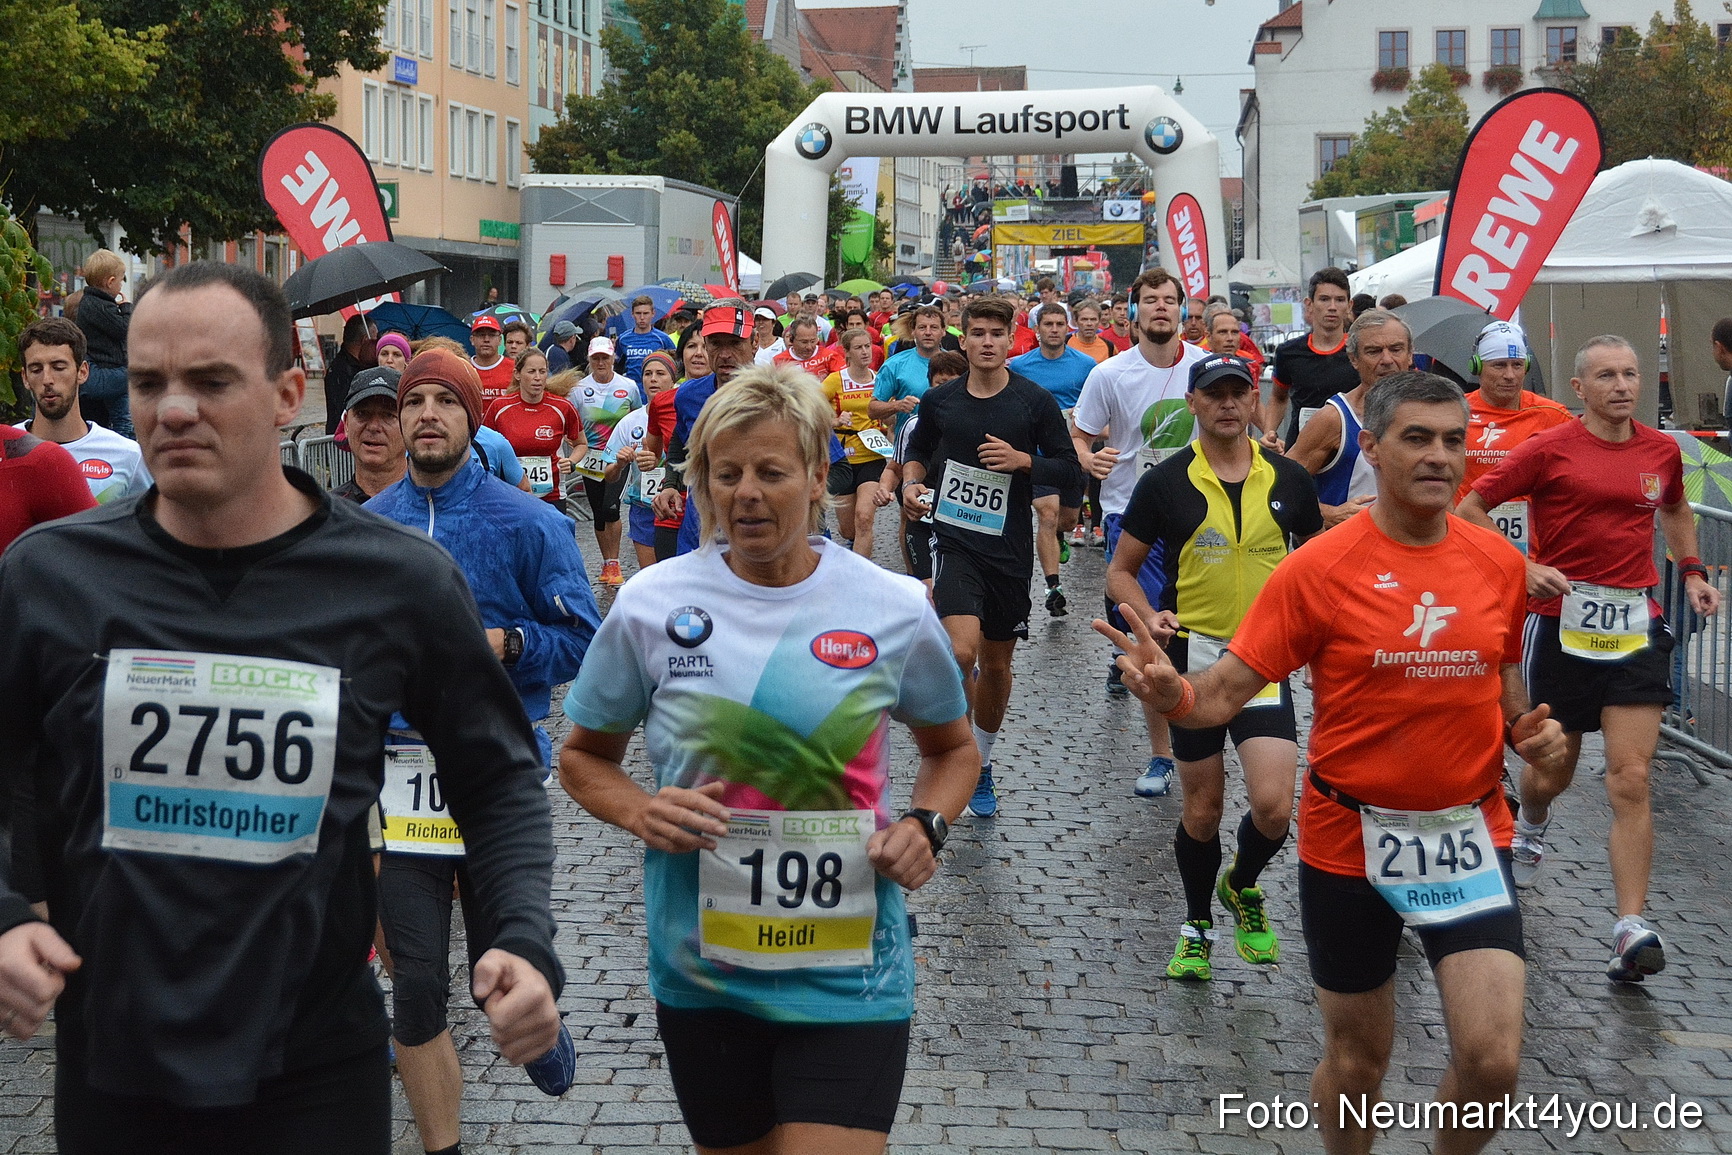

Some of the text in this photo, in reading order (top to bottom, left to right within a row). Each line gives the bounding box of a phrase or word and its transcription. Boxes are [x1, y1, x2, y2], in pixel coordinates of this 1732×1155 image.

[845, 104, 1130, 139] BMW Laufsport
[1451, 119, 1579, 313] REWE
[1052, 228, 1085, 241] ZIEL
[481, 388, 499, 396] ARKT
[1465, 449, 1510, 457] unrunner
[82, 463, 109, 475] Hervis
[946, 477, 1004, 512] 2556
[956, 508, 982, 523] David
[1490, 517, 1523, 539] 95
[1373, 581, 1399, 589] erima
[670, 606, 710, 622] BMW
[1580, 600, 1631, 631] 201
[820, 638, 871, 658] Hervis
[1590, 636, 1619, 650] Horst
[669, 655, 714, 668] PARTL
[1372, 649, 1478, 667] funrunners
[126, 662, 318, 693] NeuerMarkt BOCK
[670, 668, 714, 678] Neumarkt
[1405, 661, 1488, 678] neumarkt
[129, 701, 314, 785] 2756
[114, 767, 122, 779] D
[407, 772, 446, 812] 10
[135, 794, 299, 836] Christopher
[406, 822, 461, 839] Richard
[728, 816, 860, 837] uerMarkt BOCK
[1377, 827, 1483, 878] 2145
[739, 848, 843, 909] 198
[706, 897, 713, 908] B
[1406, 886, 1466, 907] Robert
[757, 924, 816, 947] Heidi
